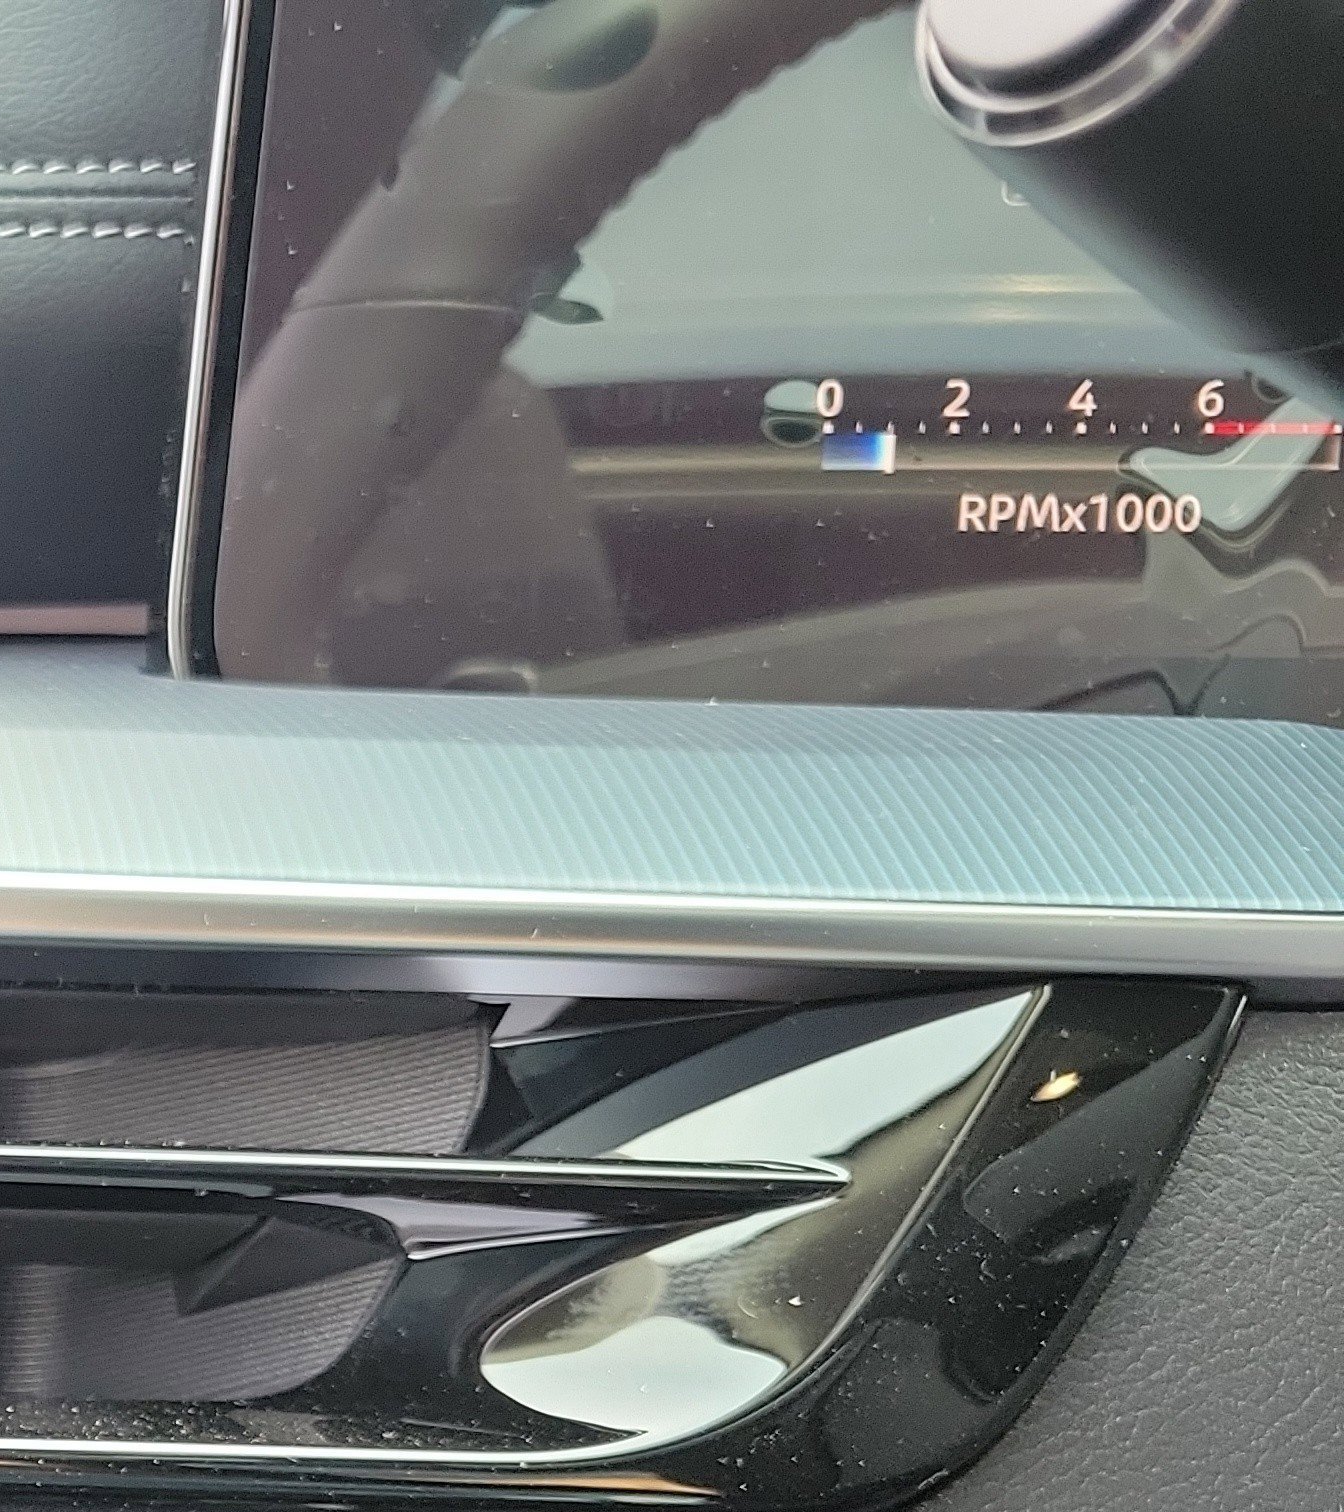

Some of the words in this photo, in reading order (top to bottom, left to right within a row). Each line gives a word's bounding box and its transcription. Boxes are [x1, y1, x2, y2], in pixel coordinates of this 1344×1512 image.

[816, 379, 844, 418] 0
[943, 379, 970, 418] 2
[1069, 379, 1097, 418] 4
[1197, 379, 1225, 418] 6
[957, 494, 1202, 533] RPMx1000
